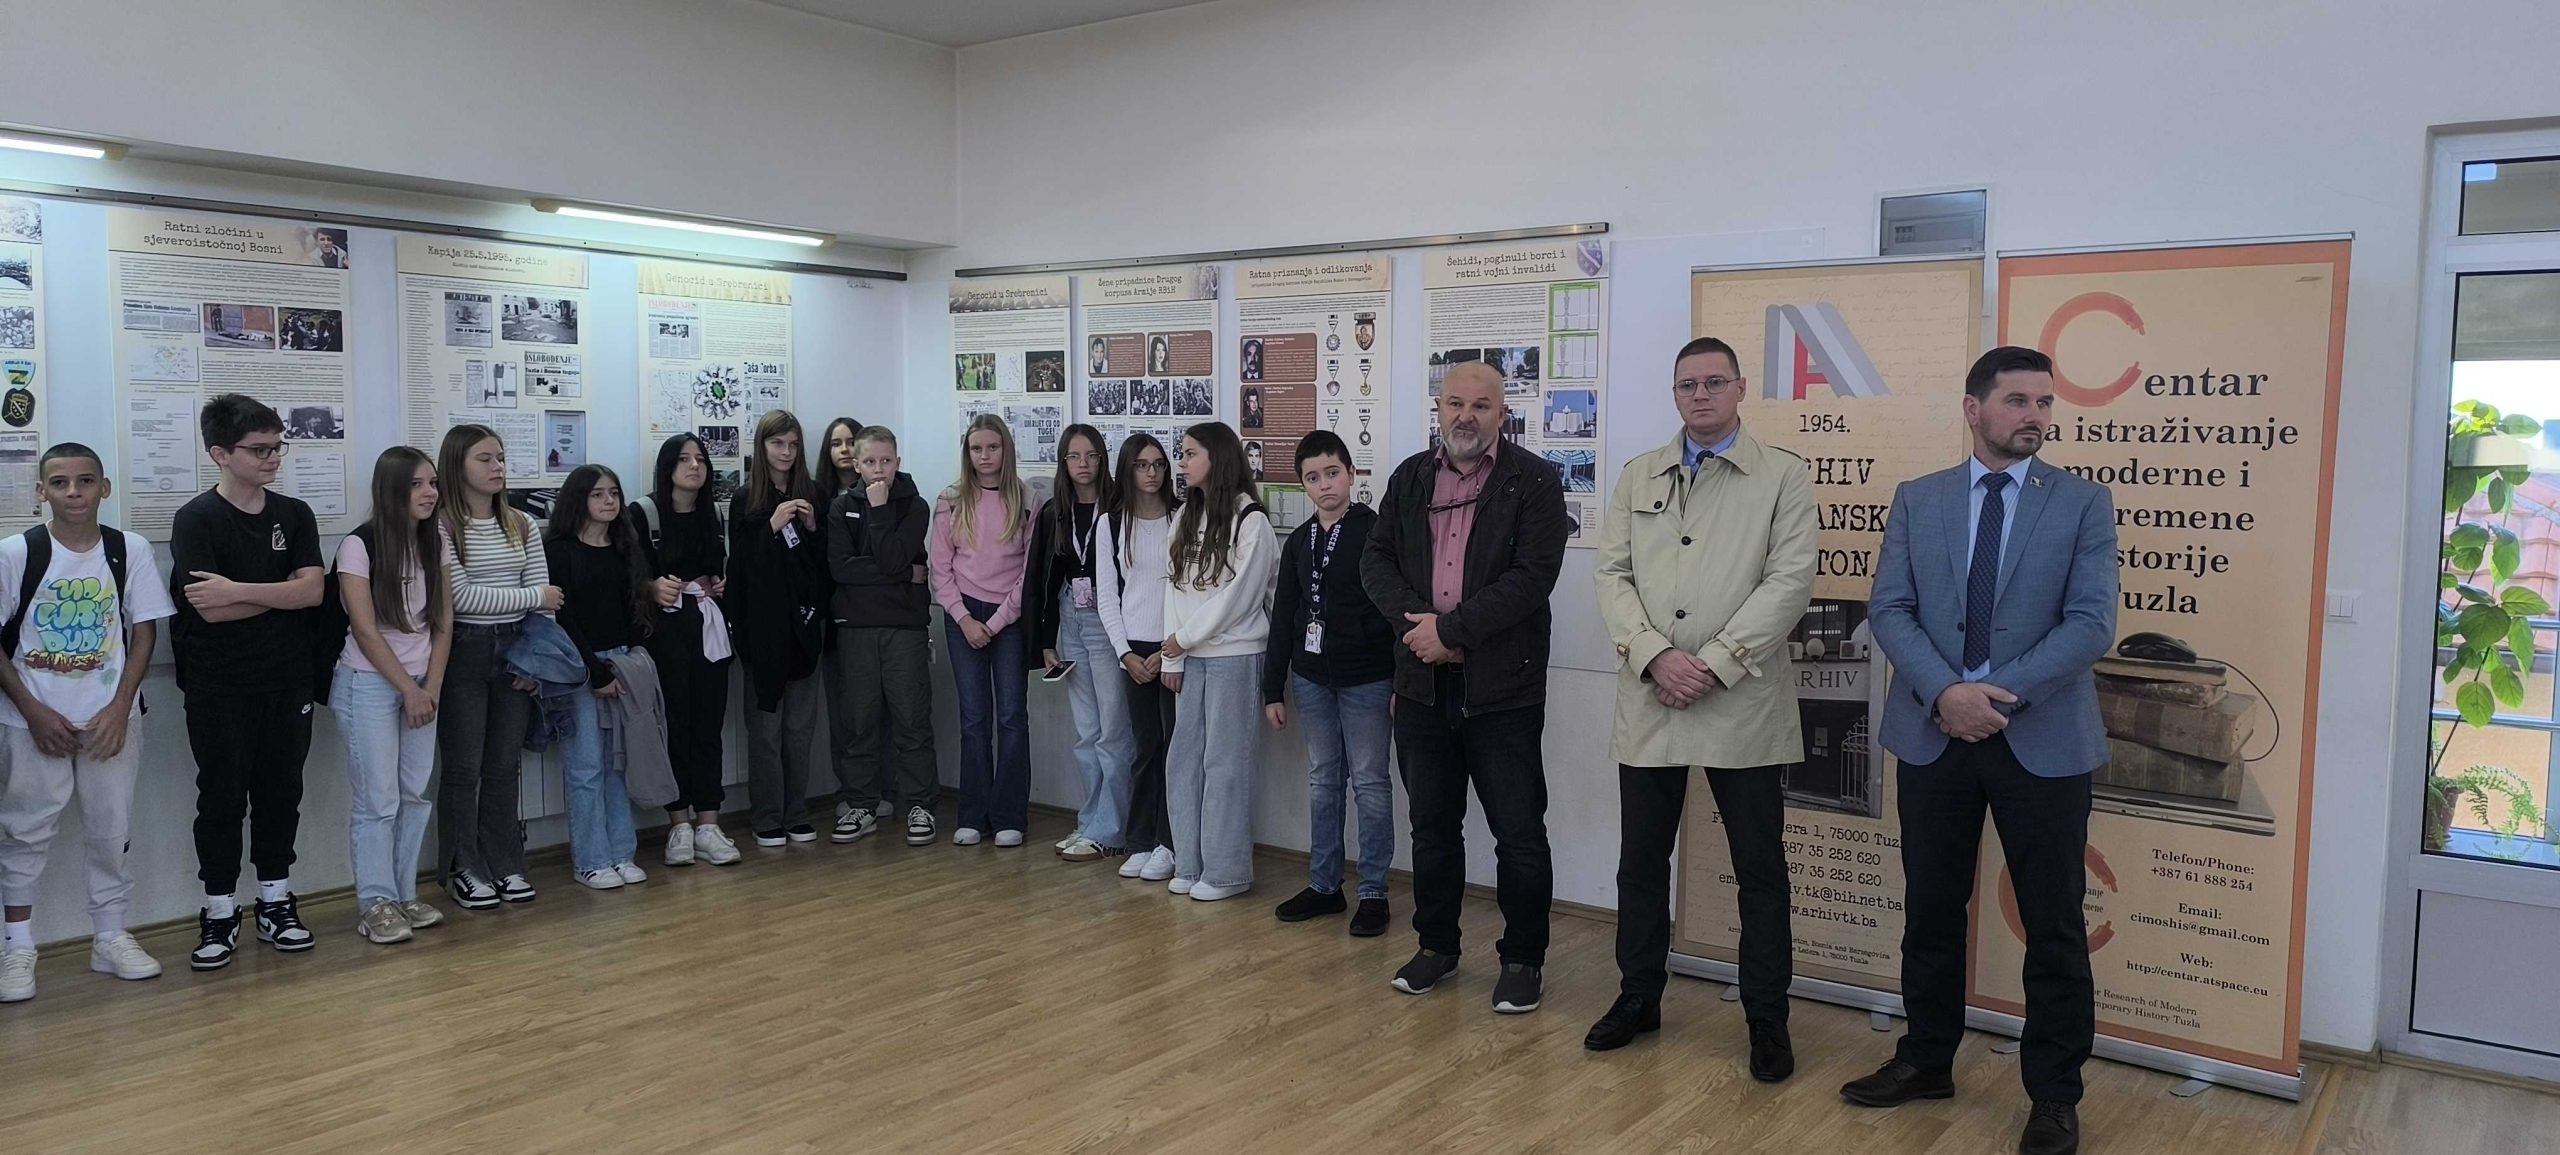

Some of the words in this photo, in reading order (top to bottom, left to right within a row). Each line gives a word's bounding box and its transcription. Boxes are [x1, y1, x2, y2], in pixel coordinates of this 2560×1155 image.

[164, 220, 201, 234] Ratni
[204, 224, 254, 239] zločini
[256, 231, 264, 240] u
[144, 233, 247, 254] sjeveroistočnoj
[250, 243, 284, 255] Bosni
[428, 245, 461, 259] Kapija
[464, 250, 513, 263] 25.5.1995.
[515, 256, 548, 266] godine
[1447, 255, 1482, 267] Šehidi,
[1484, 252, 1528, 266] poginuli
[1530, 250, 1558, 261] borci
[1560, 250, 1566, 260] i
[666, 272, 705, 285] Genocid
[717, 277, 769, 291] Srebrenici
[1098, 276, 1114, 288] Žene
[1115, 277, 1155, 288] pripadnice
[1157, 274, 1183, 286] Drugog
[1249, 270, 1271, 279] Ratna
[1273, 267, 1313, 280] priznanja
[1314, 267, 1319, 275] i
[1321, 263, 1373, 276] odlikovanja
[1456, 268, 1481, 279] ratni
[1484, 268, 1510, 278] vojni
[1512, 263, 1557, 275] invalidi
[967, 289, 997, 301] Genocid
[998, 290, 1004, 300] u
[1005, 287, 1049, 299] Srebrenici
[1104, 288, 1133, 299] korpusa
[1134, 287, 1157, 299] Armije
[1799, 414, 1851, 433] 1954.
[2044, 423, 2063, 442] a
[2075, 416, 2299, 451] istraživanje
[2239, 460, 2251, 488] i
[2114, 506, 2255, 532] remene
[1326, 524, 1342, 552] SOCCER
[1815, 547, 1876, 578] TON
[2116, 544, 2230, 578] storije
[2118, 585, 2199, 614] uzla
[34, 594, 114, 630] WAY
[1783, 822, 1808, 836] era
[1829, 826, 1869, 844] 75000
[1874, 832, 1902, 849] Tuz
[1783, 841, 1804, 855] 387
[1808, 844, 1824, 858] 35
[1828, 847, 1852, 862] 252
[1856, 851, 1881, 866] 620
[2152, 848, 2255, 875] Telefon/Phone:
[1809, 865, 1825, 879] 35
[1829, 868, 1853, 883] 252
[1857, 871, 1882, 887] 620
[2151, 866, 2181, 880] +387
[2185, 872, 2200, 883] 61
[2204, 874, 2227, 887] 888
[2230, 878, 2253, 892] 254
[1789, 884, 1903, 911] iv.tk@bih.net.ba
[2086, 887, 2104, 899] anje
[1790, 904, 1878, 928] w.arhivtk.ba
[2083, 903, 2104, 913] mene
[2178, 902, 2222, 920] Email:
[2130, 912, 2271, 946] cimoshis@gmail.com
[1834, 944, 1847, 953] and
[2180, 952, 2214, 969] Web:
[2126, 959, 2268, 997] http://centar.atspace.eu
[2104, 988, 2146, 1006] Research
[2148, 995, 2158, 1008] of
[2159, 1001, 2198, 1016] Modern
[2094, 1000, 2133, 1015] mporary
[2135, 1006, 2171, 1024] History
[2173, 1015, 2201, 1029] Tuzla
